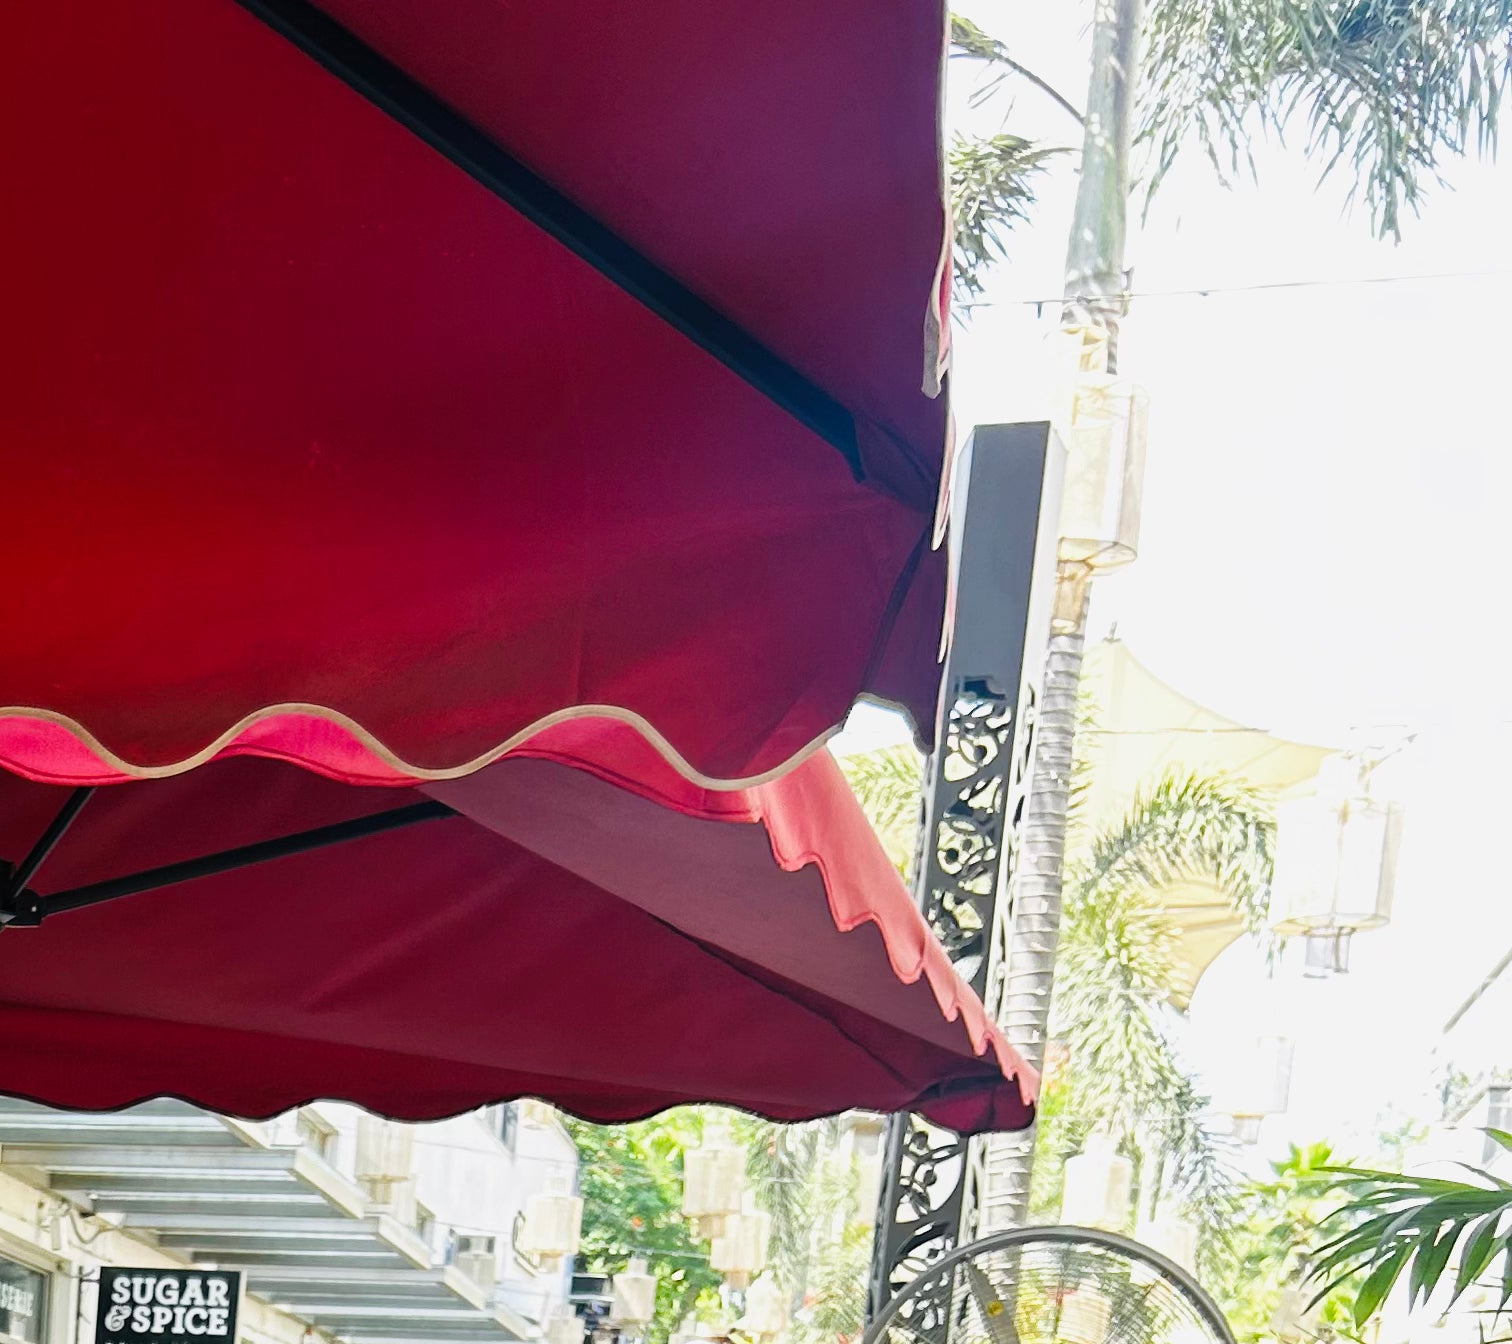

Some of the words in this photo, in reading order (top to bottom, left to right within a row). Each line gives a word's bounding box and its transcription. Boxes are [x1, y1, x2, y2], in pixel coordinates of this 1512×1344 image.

[111, 1275, 230, 1308] SUGAR
[104, 1305, 132, 1332] &
[131, 1305, 230, 1336] SPICE
